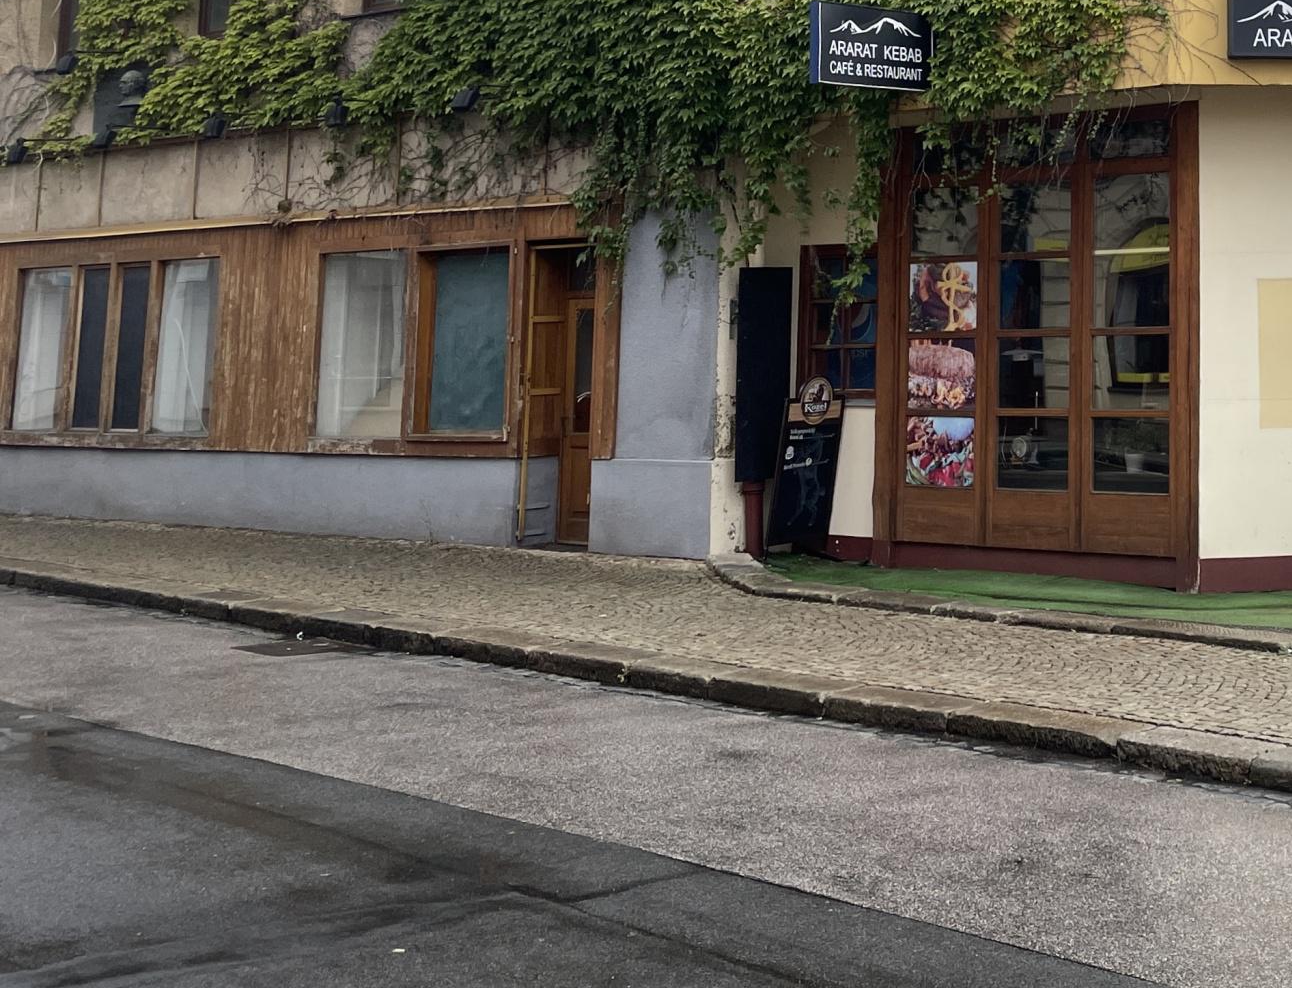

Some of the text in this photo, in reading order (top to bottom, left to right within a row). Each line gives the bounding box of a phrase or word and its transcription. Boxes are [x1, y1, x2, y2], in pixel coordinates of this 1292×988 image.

[829, 40, 922, 62] ARARAT KEBAB
[830, 59, 922, 81] CAFÉ & RESTAURANT
[804, 402, 827, 413] Kozel
